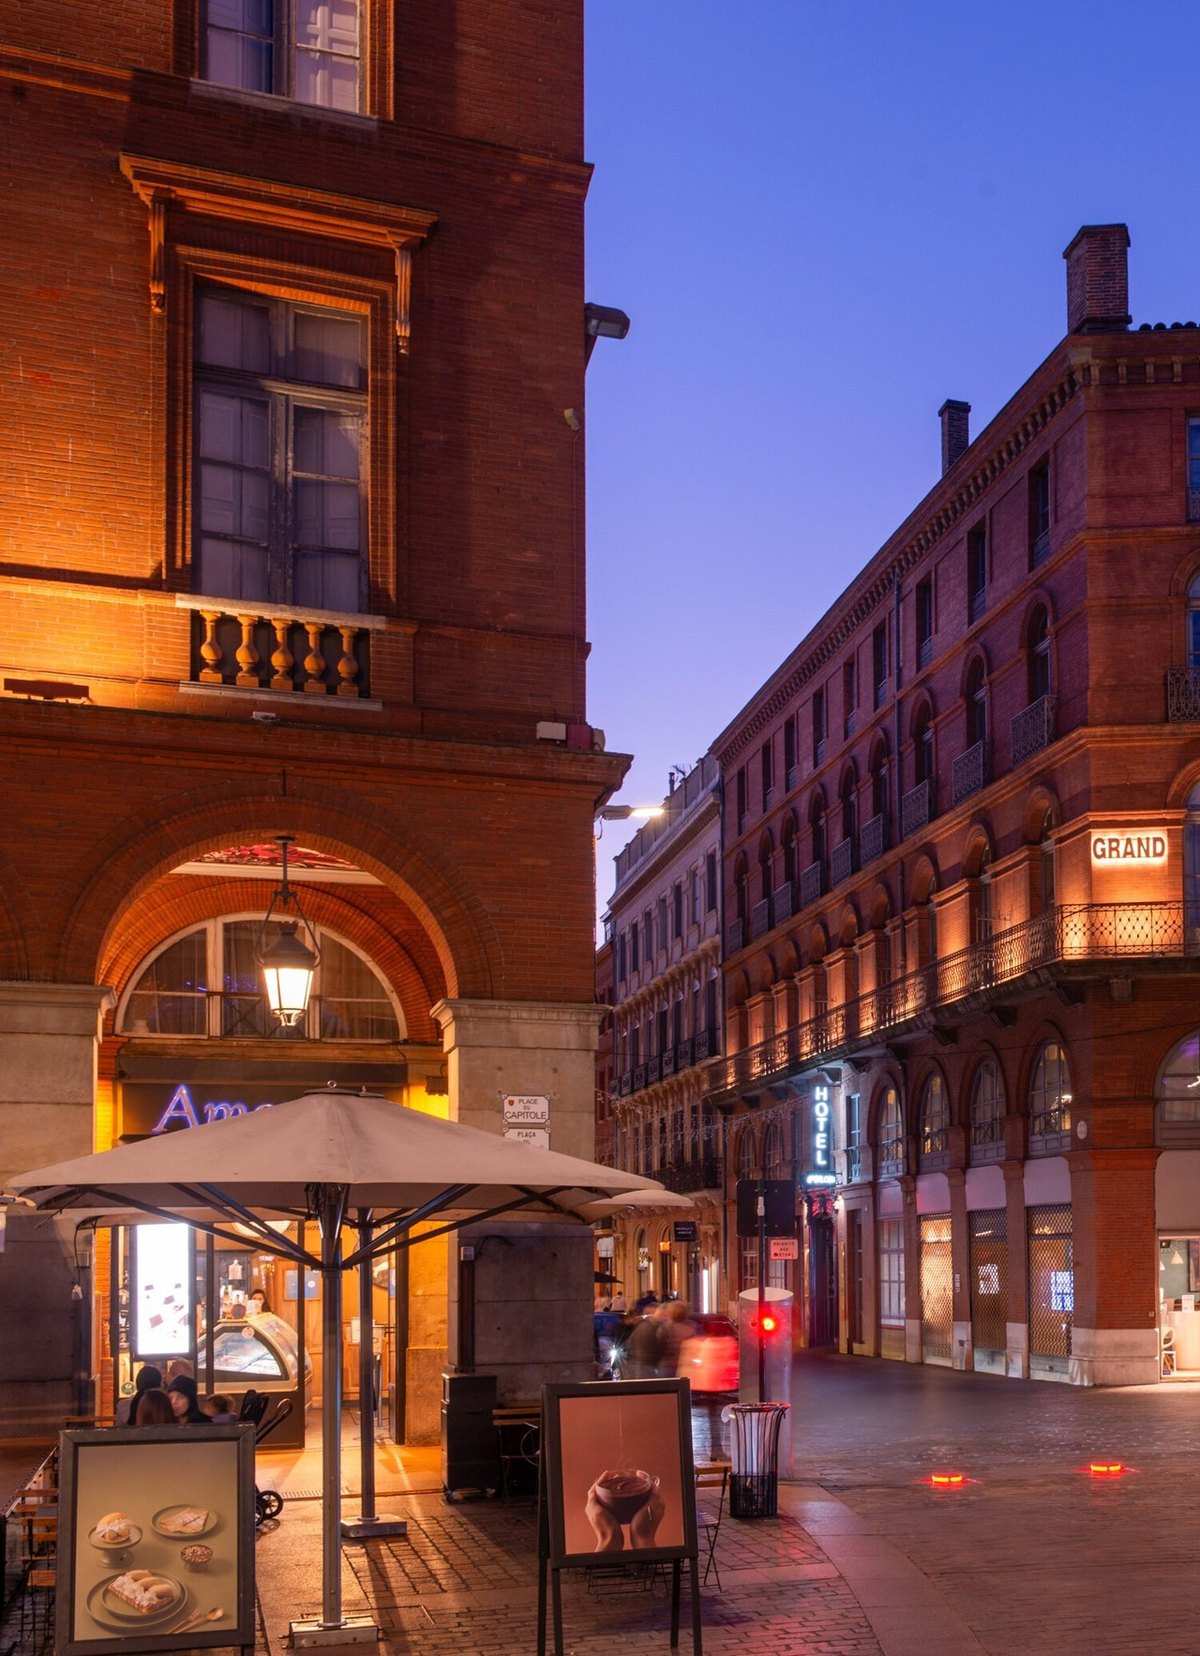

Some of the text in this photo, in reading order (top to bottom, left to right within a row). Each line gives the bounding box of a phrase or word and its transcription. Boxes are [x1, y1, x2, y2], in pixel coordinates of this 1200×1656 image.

[1093, 836, 1165, 859] GRAND
[505, 1111, 546, 1119] CAPITOLE
[815, 1086, 829, 1165] HOTEL
